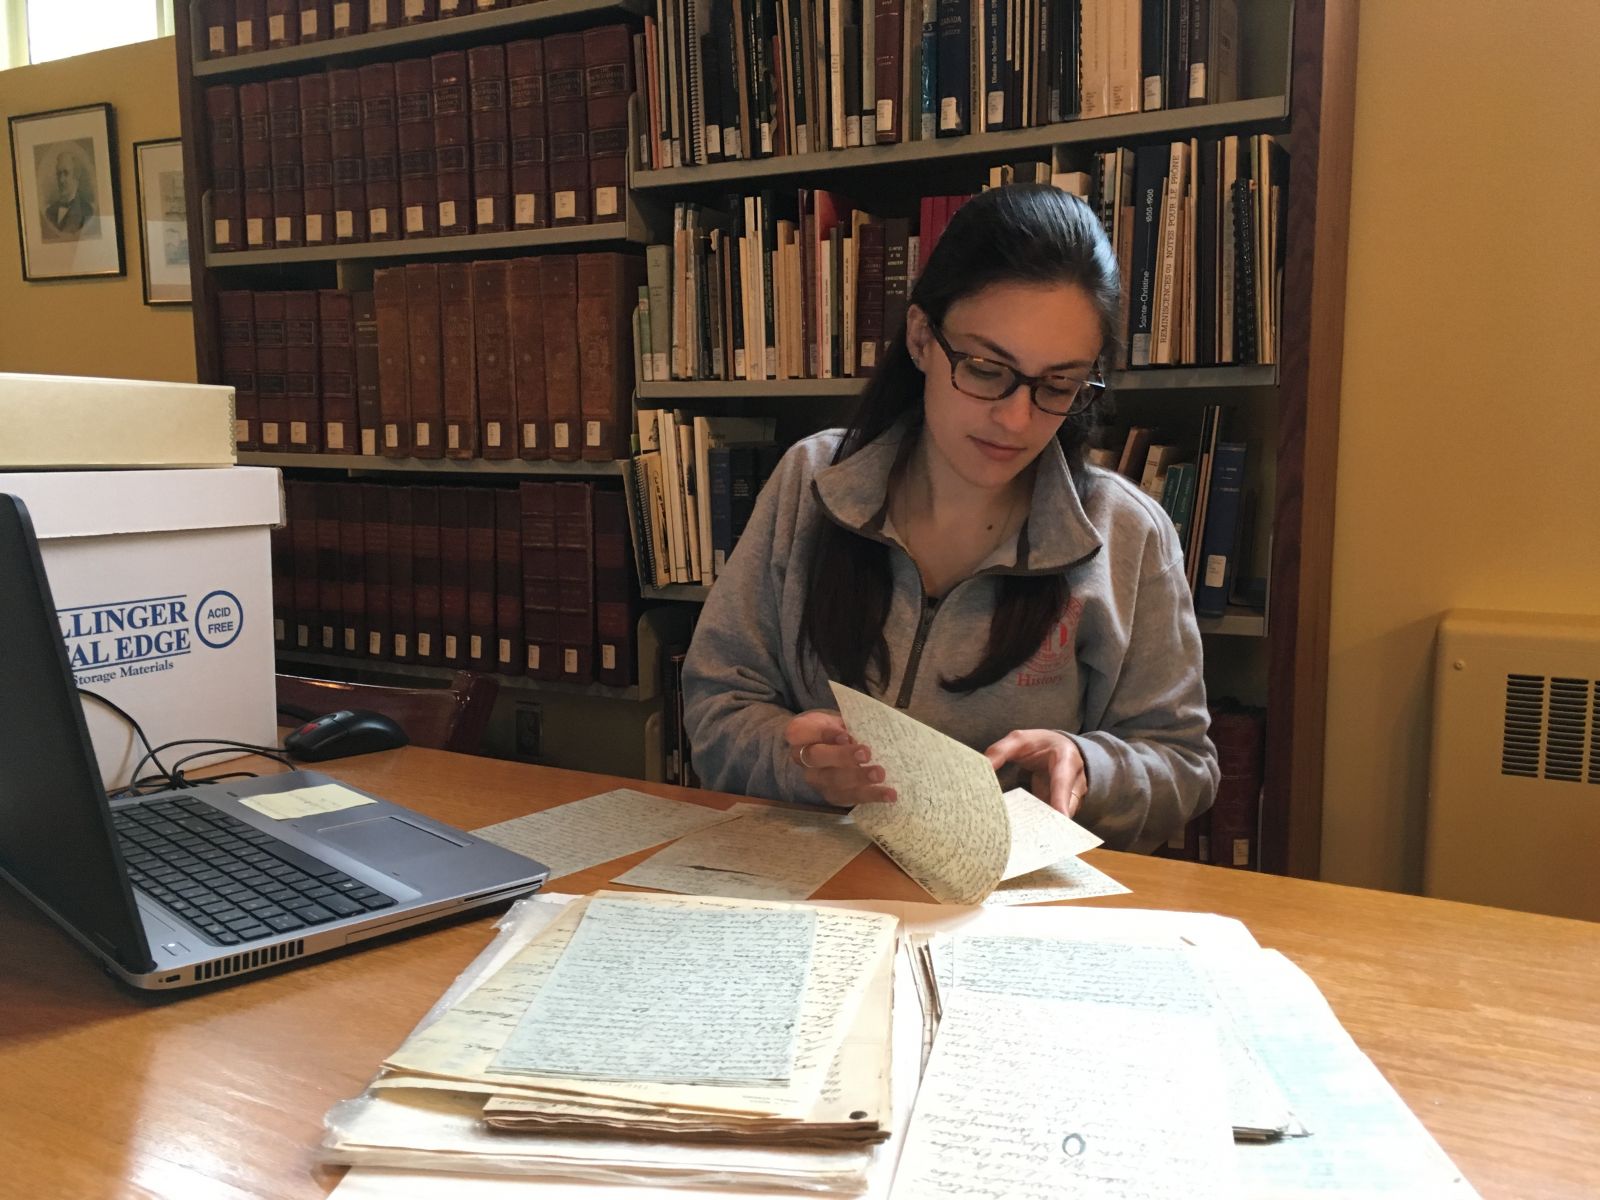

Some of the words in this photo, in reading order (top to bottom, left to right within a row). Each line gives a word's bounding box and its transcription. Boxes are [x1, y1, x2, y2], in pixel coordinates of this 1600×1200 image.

[1170, 188, 1178, 200] LE
[1168, 203, 1177, 226] POUR
[1166, 230, 1175, 258] NOTES
[1139, 271, 1150, 328] Sainte-Christine
[1160, 274, 1174, 343] REMINISCENCES
[207, 607, 231, 619] ACID
[208, 621, 234, 634] FREE
[66, 640, 109, 668] AL
[114, 628, 191, 661] EDGE
[73, 671, 117, 688] Storage
[119, 660, 174, 678] Materials
